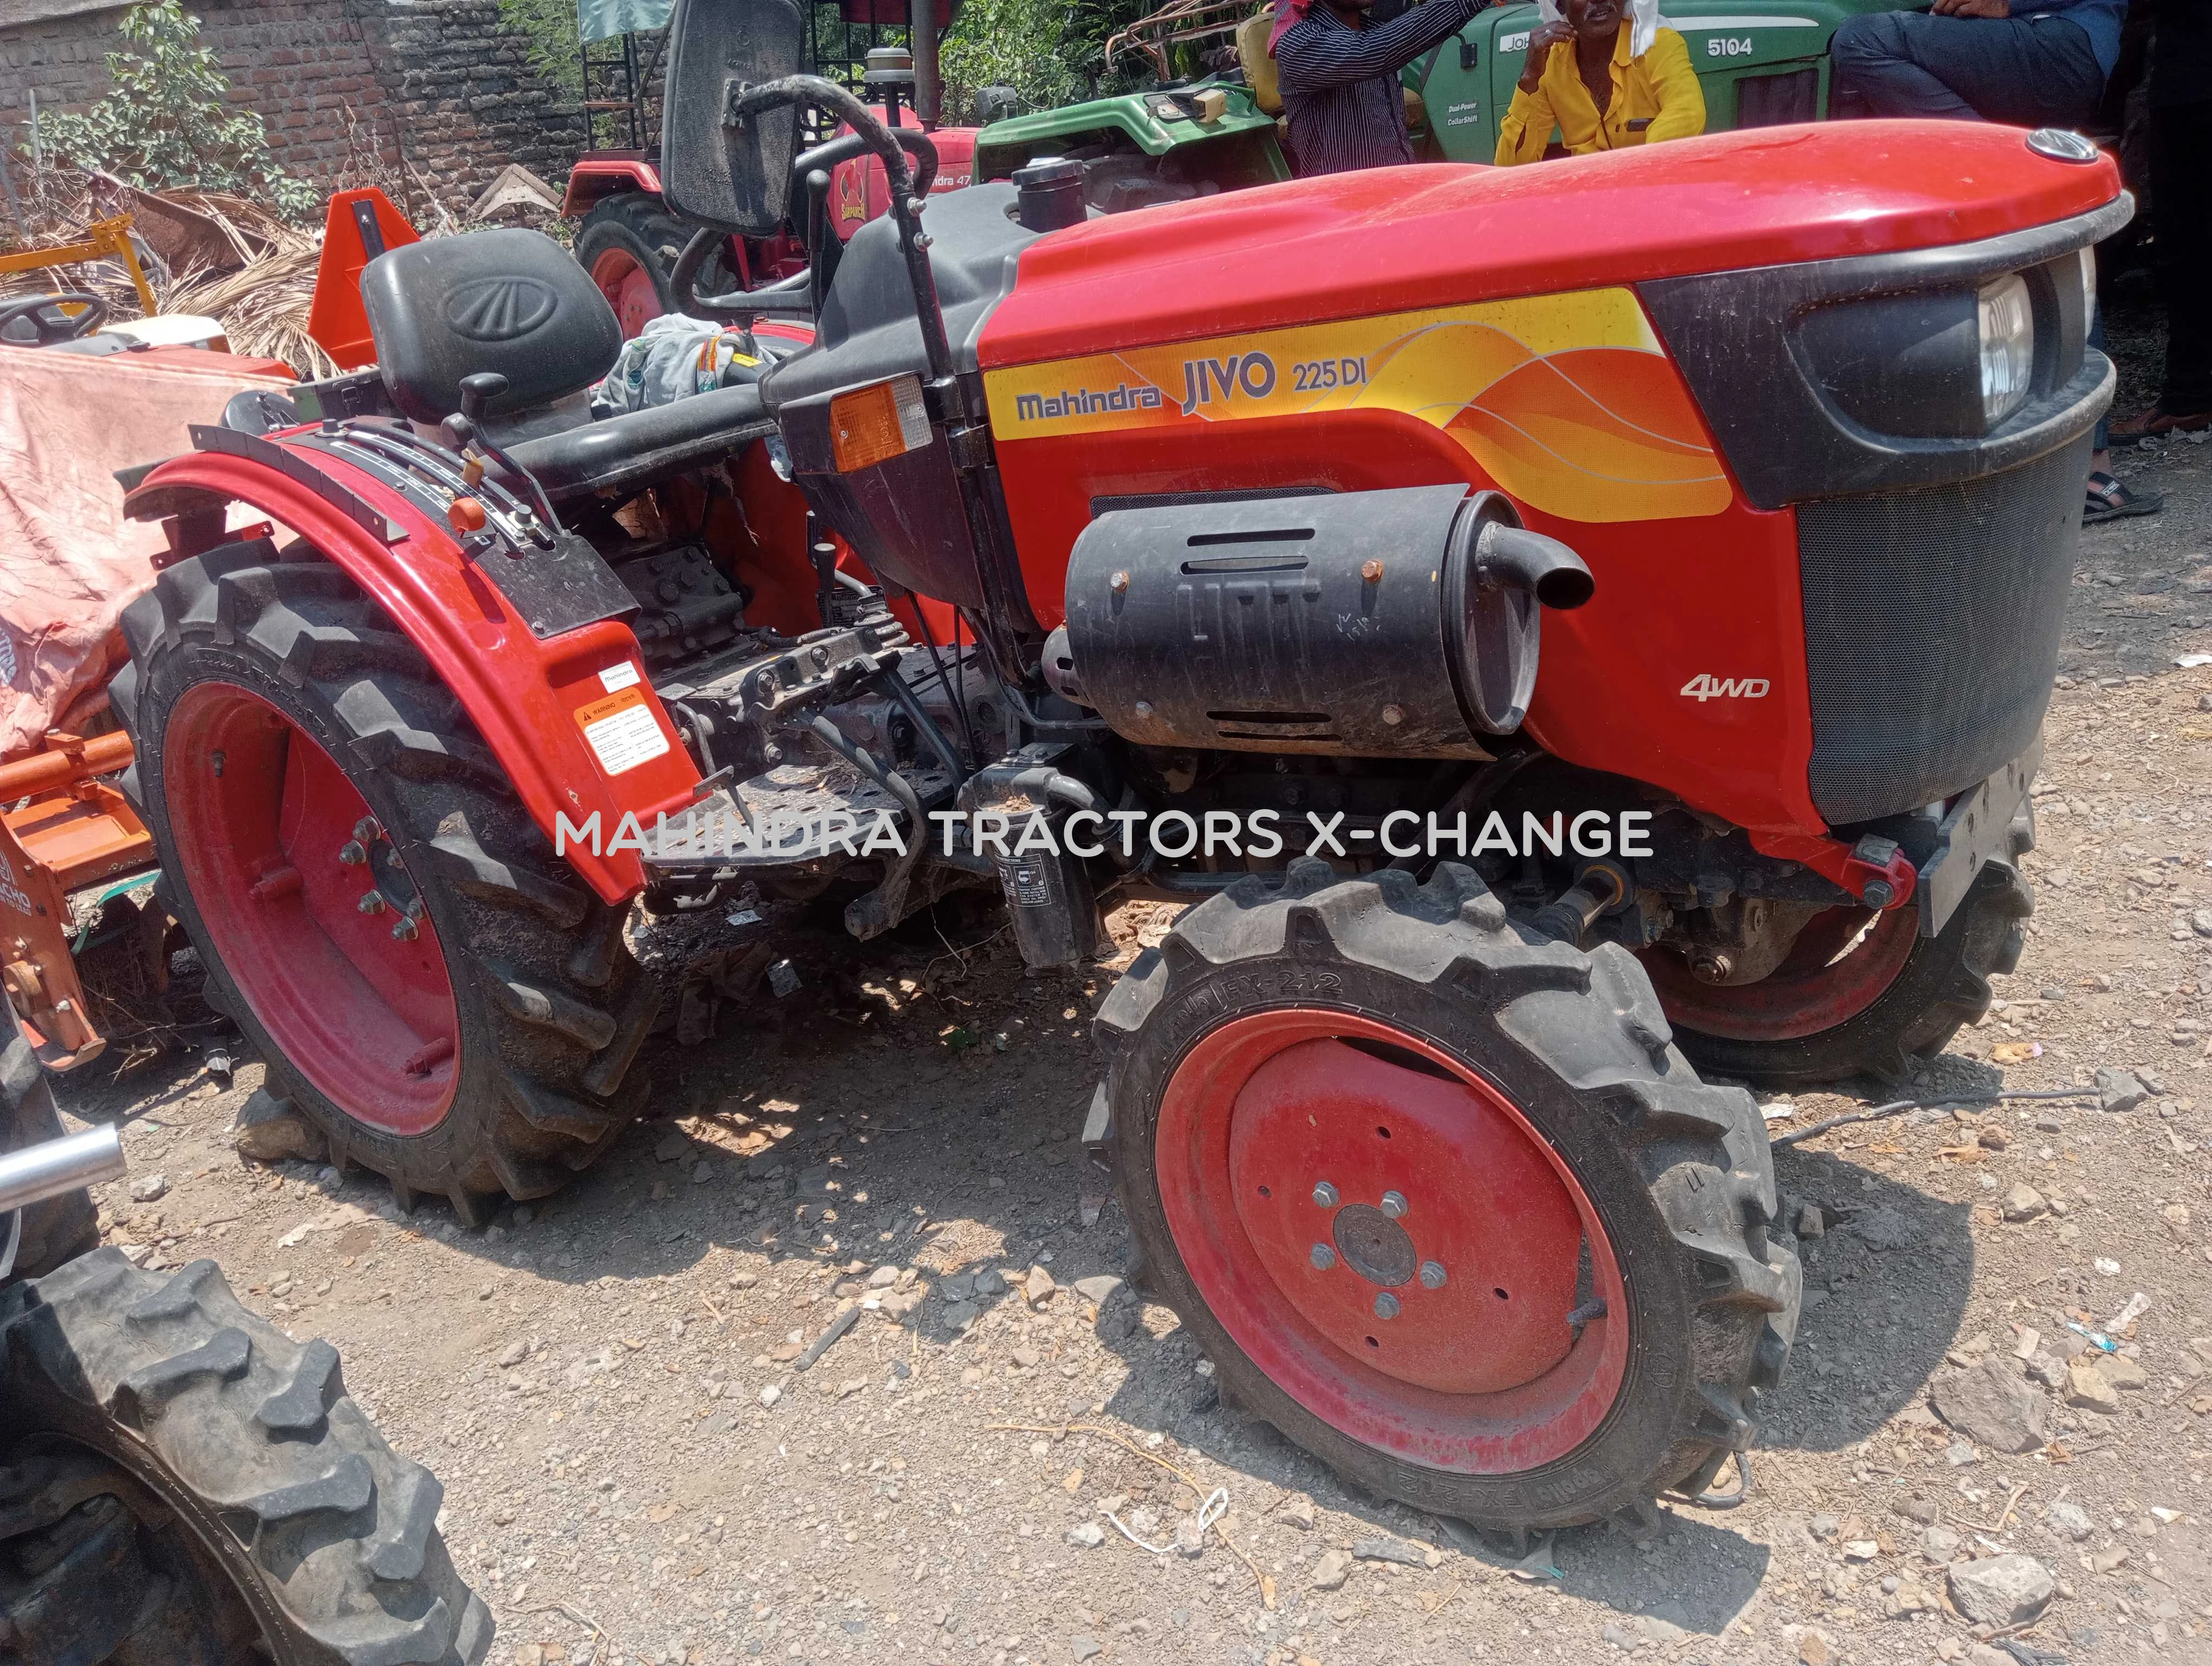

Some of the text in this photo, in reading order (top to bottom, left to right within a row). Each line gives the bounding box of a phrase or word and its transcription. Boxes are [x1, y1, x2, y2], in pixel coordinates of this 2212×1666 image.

[1708, 37, 1753, 56] 5104
[1448, 102, 1477, 113] Dual-Power
[1448, 114, 1478, 126] CollarShift
[931, 175, 972, 187] ndra 47
[841, 202, 866, 221] SARPANCH
[1015, 382, 1162, 421] Mahindra
[1181, 350, 1277, 416] JIVO
[1680, 674, 1770, 702] 4WD
